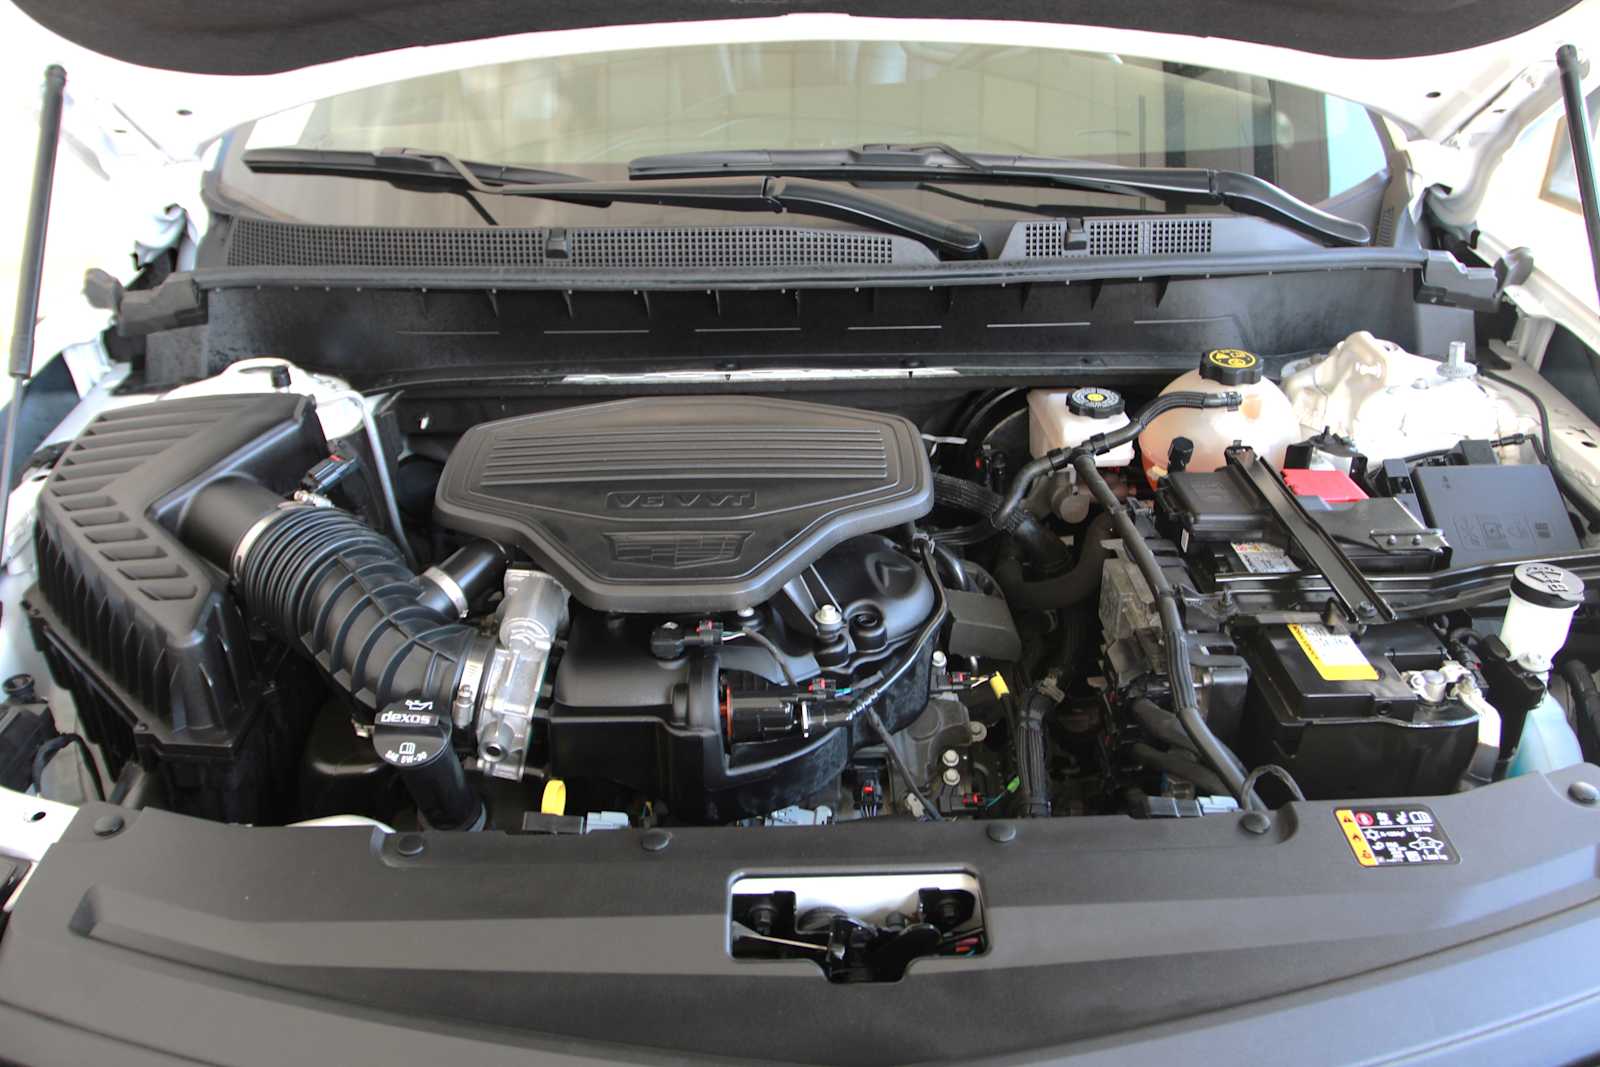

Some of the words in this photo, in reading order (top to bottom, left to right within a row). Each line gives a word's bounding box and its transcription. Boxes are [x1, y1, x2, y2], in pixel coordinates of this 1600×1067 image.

[616, 493, 665, 508] V6
[676, 492, 750, 507] VVT
[381, 711, 431, 724] dexos
